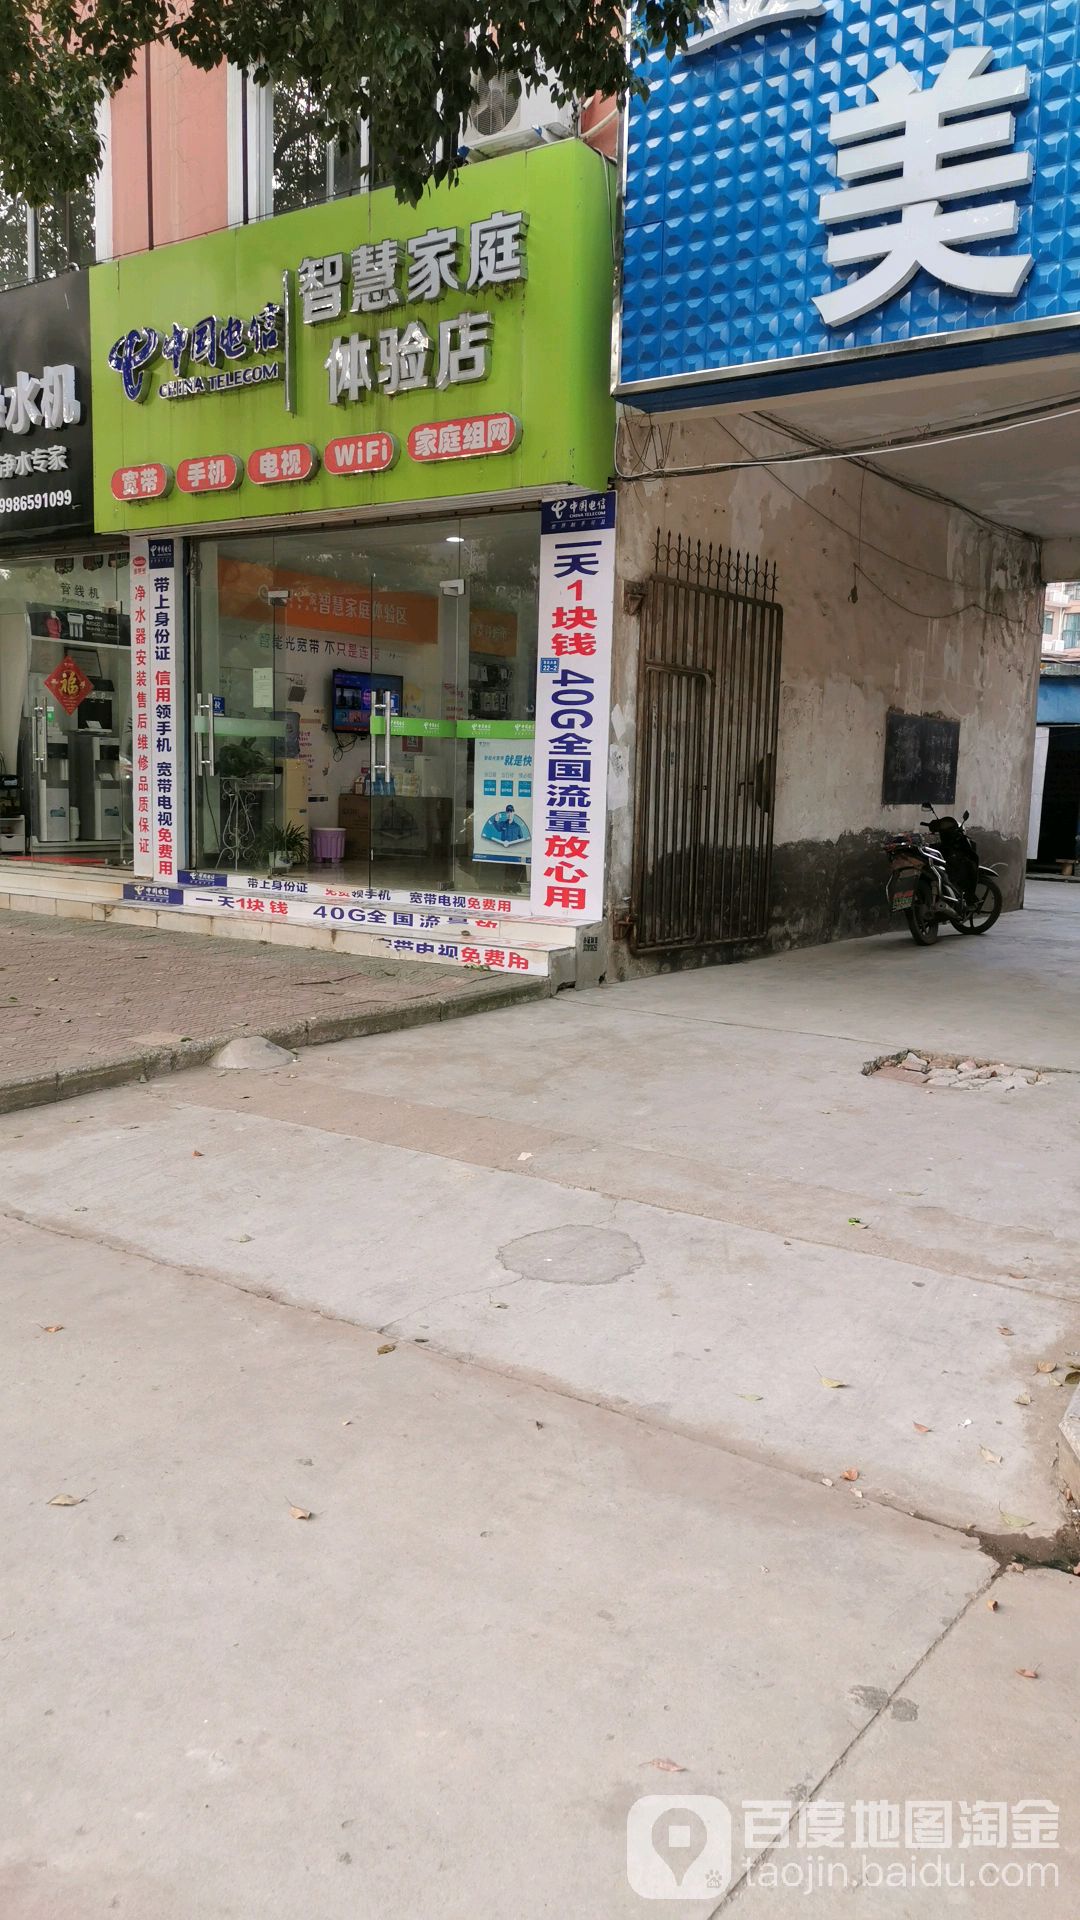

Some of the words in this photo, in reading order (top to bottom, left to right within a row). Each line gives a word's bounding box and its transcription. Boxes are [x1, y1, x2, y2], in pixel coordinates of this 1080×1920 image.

[811, 46, 1033, 328] 美
[299, 210, 530, 327] 智慧家庭
[162, 302, 280, 377] 中国电信
[325, 310, 493, 408] 体验店
[0, 364, 81, 434] 水机
[159, 376, 204, 399] CHINA
[208, 362, 279, 392] TELECOM
[258, 449, 302, 477] 电视
[334, 437, 388, 467] WiFi
[414, 416, 511, 457] 家庭组网
[121, 469, 158, 495] 宽带
[187, 459, 228, 487] 手机
[154, 577, 171, 661] 带上身份证
[551, 541, 602, 657] 一天1块钱
[59, 671, 80, 696] 福
[134, 585, 150, 853] 净水器安装售后维修品质保证
[155, 670, 172, 753] 信用领手机
[156, 761, 173, 876] 宽带电视免费用
[543, 669, 595, 910] 40G全国流量放心用
[196, 895, 288, 915] 一天1块钱
[247, 878, 308, 894] 带上身份证
[409, 891, 512, 913] 宽带电视免费用
